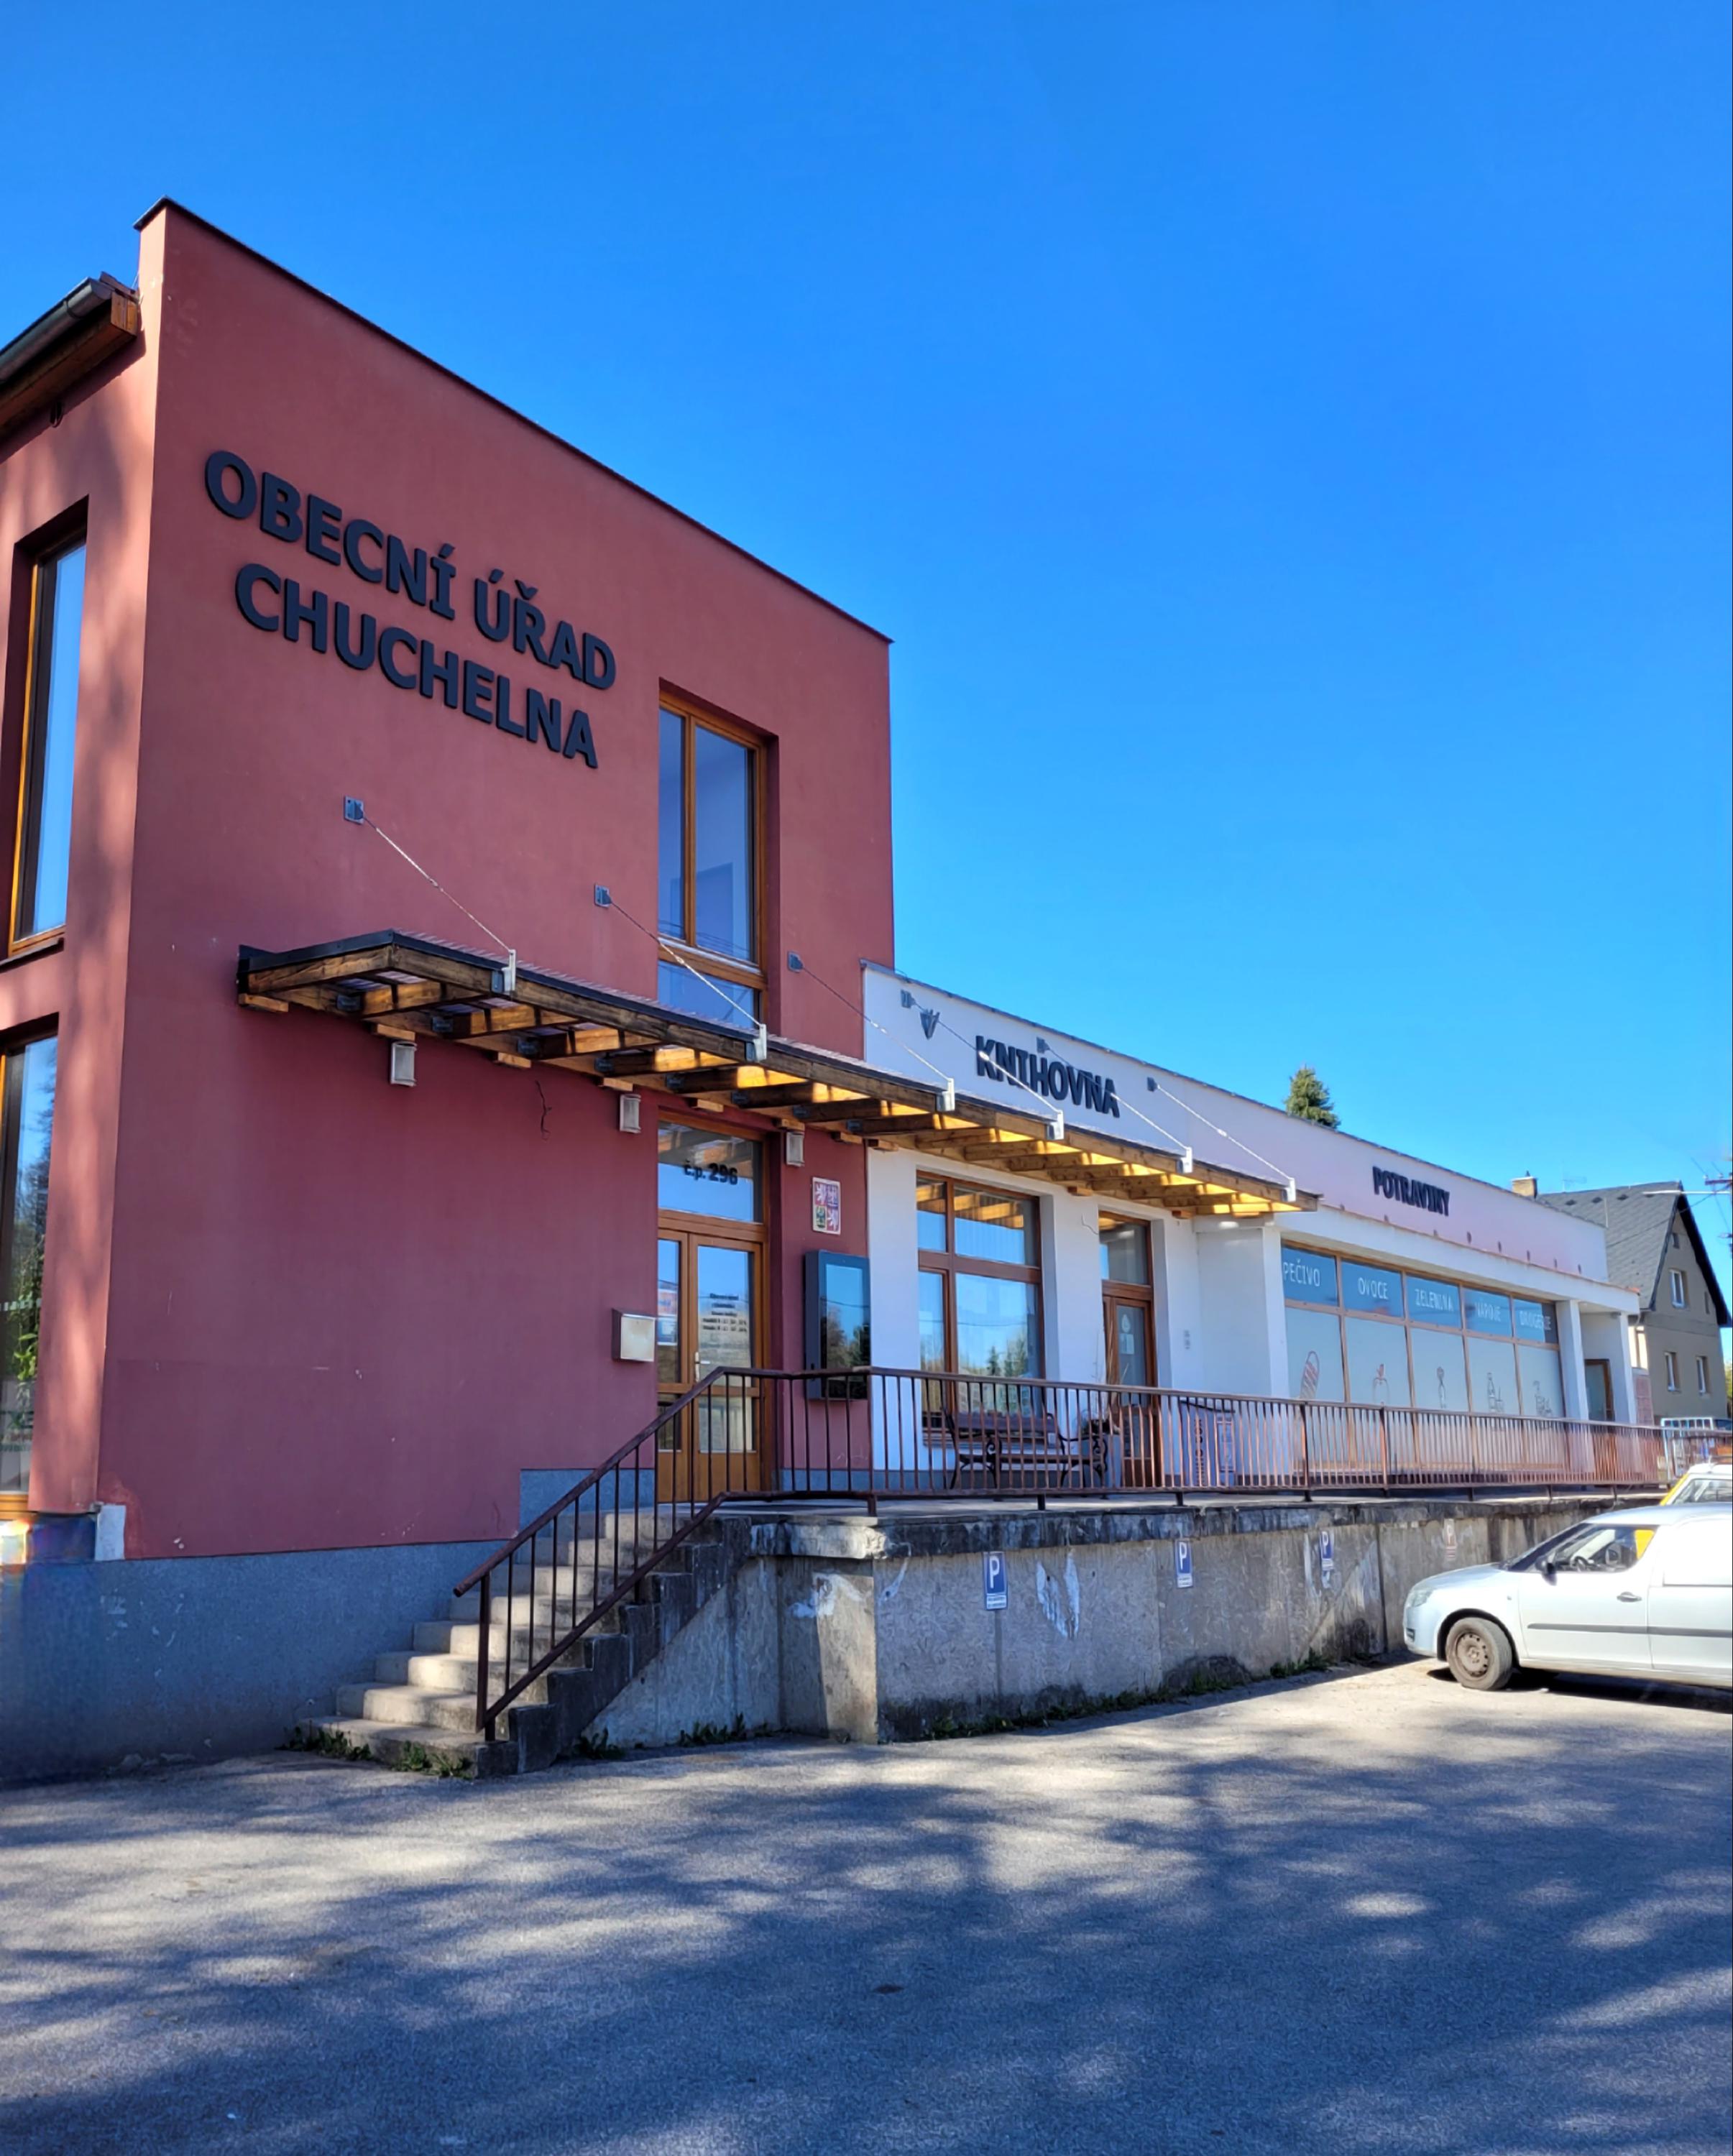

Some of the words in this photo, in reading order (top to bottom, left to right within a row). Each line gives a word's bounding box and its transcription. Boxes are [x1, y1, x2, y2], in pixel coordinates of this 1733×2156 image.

[205, 450, 456, 621] OBECNÍ
[474, 568, 617, 691] ÚŘAD
[234, 563, 598, 769] CHUCHELNA
[975, 1035, 1121, 1118] KNIHOVNA
[684, 1158, 706, 1181] č.p.
[708, 1162, 738, 1186] 296
[1372, 1165, 1451, 1217] POTRAVINY
[1282, 1258, 1320, 1287] PEČIVO
[1358, 1276, 1389, 1300] OVOCE
[1179, 1541, 1187, 1570] P
[1321, 1531, 1329, 1555] P
[989, 1554, 1000, 1589] P
